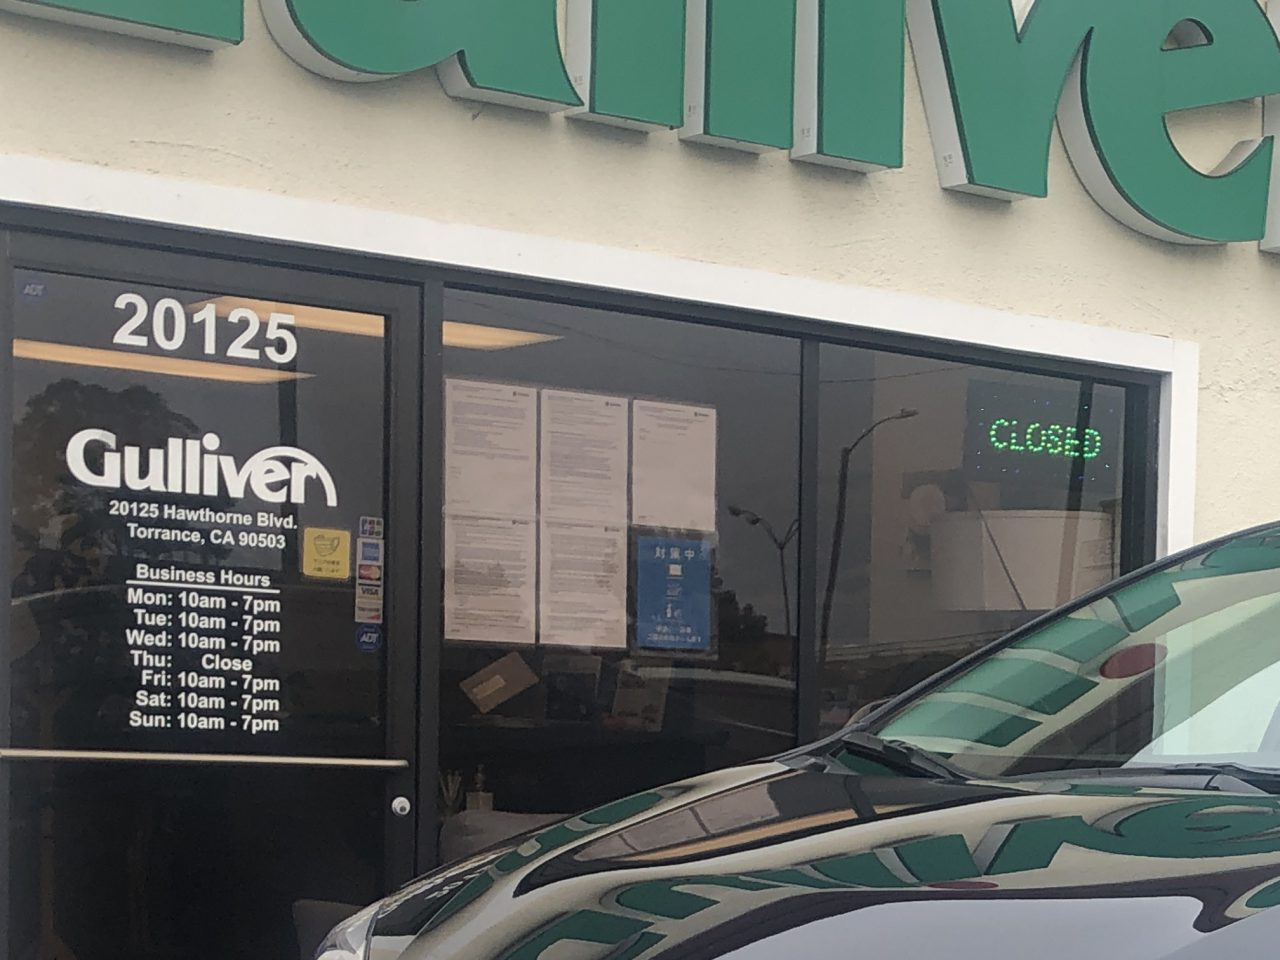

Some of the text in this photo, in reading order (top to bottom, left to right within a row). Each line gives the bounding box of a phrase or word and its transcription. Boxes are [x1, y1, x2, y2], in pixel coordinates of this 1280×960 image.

[112, 292, 299, 364] 20125
[989, 418, 1102, 459] CLOSED
[65, 428, 338, 508] Gulliver
[108, 499, 298, 530] 20125 Hawthorne Blvd.
[126, 522, 287, 550] Torrance, CA 90503
[136, 563, 272, 588] Business Hours
[127, 587, 173, 606] Mon:
[178, 590, 227, 610] 10am
[242, 595, 281, 615] 7pm
[361, 587, 379, 596] VISA
[133, 608, 173, 627] Tue:
[178, 611, 227, 630] 10am
[242, 614, 281, 635] 7pm
[125, 628, 173, 648] Wed:
[178, 631, 226, 650] 10am
[242, 635, 281, 655] 7pm
[359, 632, 380, 644] ADT
[129, 649, 253, 672] Thu: Close
[141, 669, 173, 687] Fri:
[177, 671, 226, 689] 10am
[241, 674, 280, 694] 7pm
[135, 689, 172, 708] Sat:
[177, 691, 225, 710] 10am
[241, 694, 280, 714] 7pm
[129, 710, 172, 728] Sun:
[176, 712, 225, 730] 10am
[241, 714, 279, 735] 7pm
